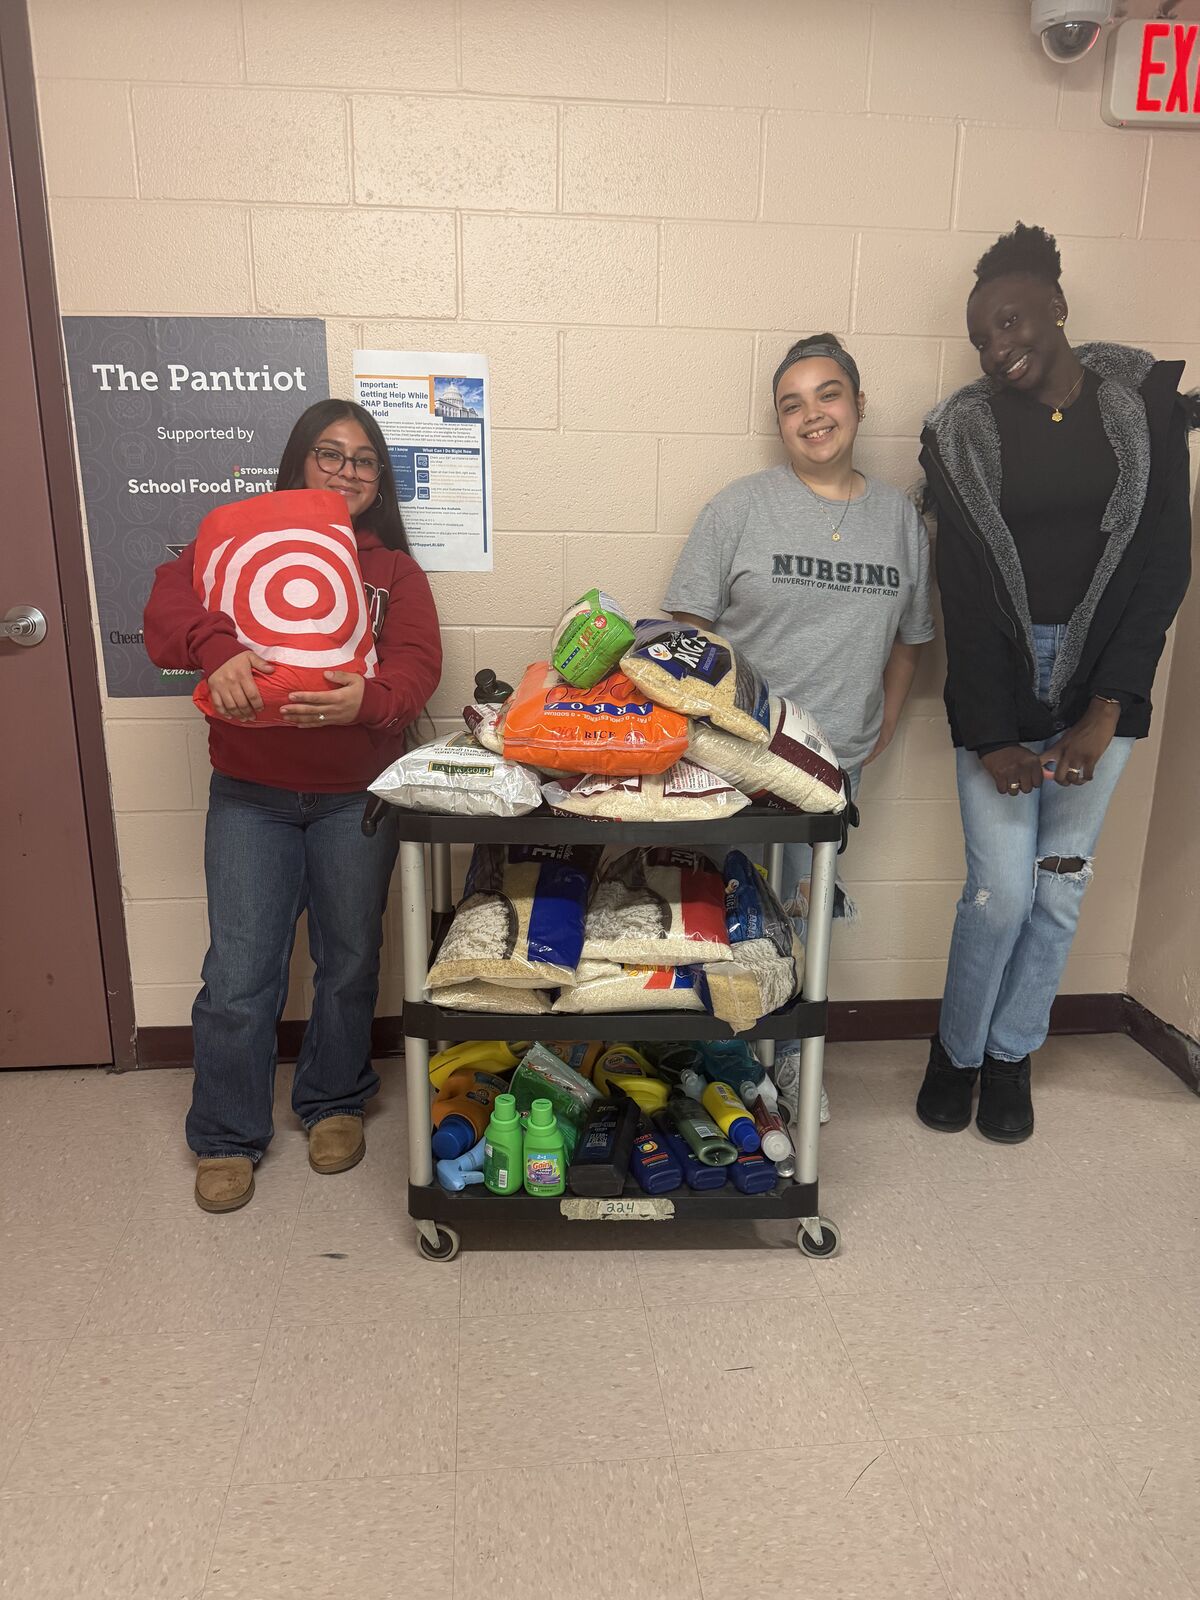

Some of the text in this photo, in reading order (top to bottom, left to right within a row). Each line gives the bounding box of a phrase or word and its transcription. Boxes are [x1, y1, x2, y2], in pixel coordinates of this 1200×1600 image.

[1136, 23, 1200, 113] EX
[91, 364, 307, 391] The Pantriot
[360, 381, 398, 389] Important:
[360, 391, 429, 400] Getting Help While
[157, 427, 254, 443] Supported by
[240, 467, 279, 475] STOP&SH
[128, 478, 186, 494] School
[189, 478, 231, 493] Food
[772, 554, 900, 589] NURSING
[772, 577, 816, 587] UNIVERSITY
[816, 581, 827, 589] OF
[827, 584, 851, 592] MAINE
[862, 587, 881, 595] FORT
[882, 588, 899, 597] KENT
[109, 629, 144, 644] Cheeri
[549, 702, 648, 715] ARROZ
[584, 731, 616, 739] RICE
[532, 1161, 550, 1170] Gain
[606, 1202, 634, 1213] 224
